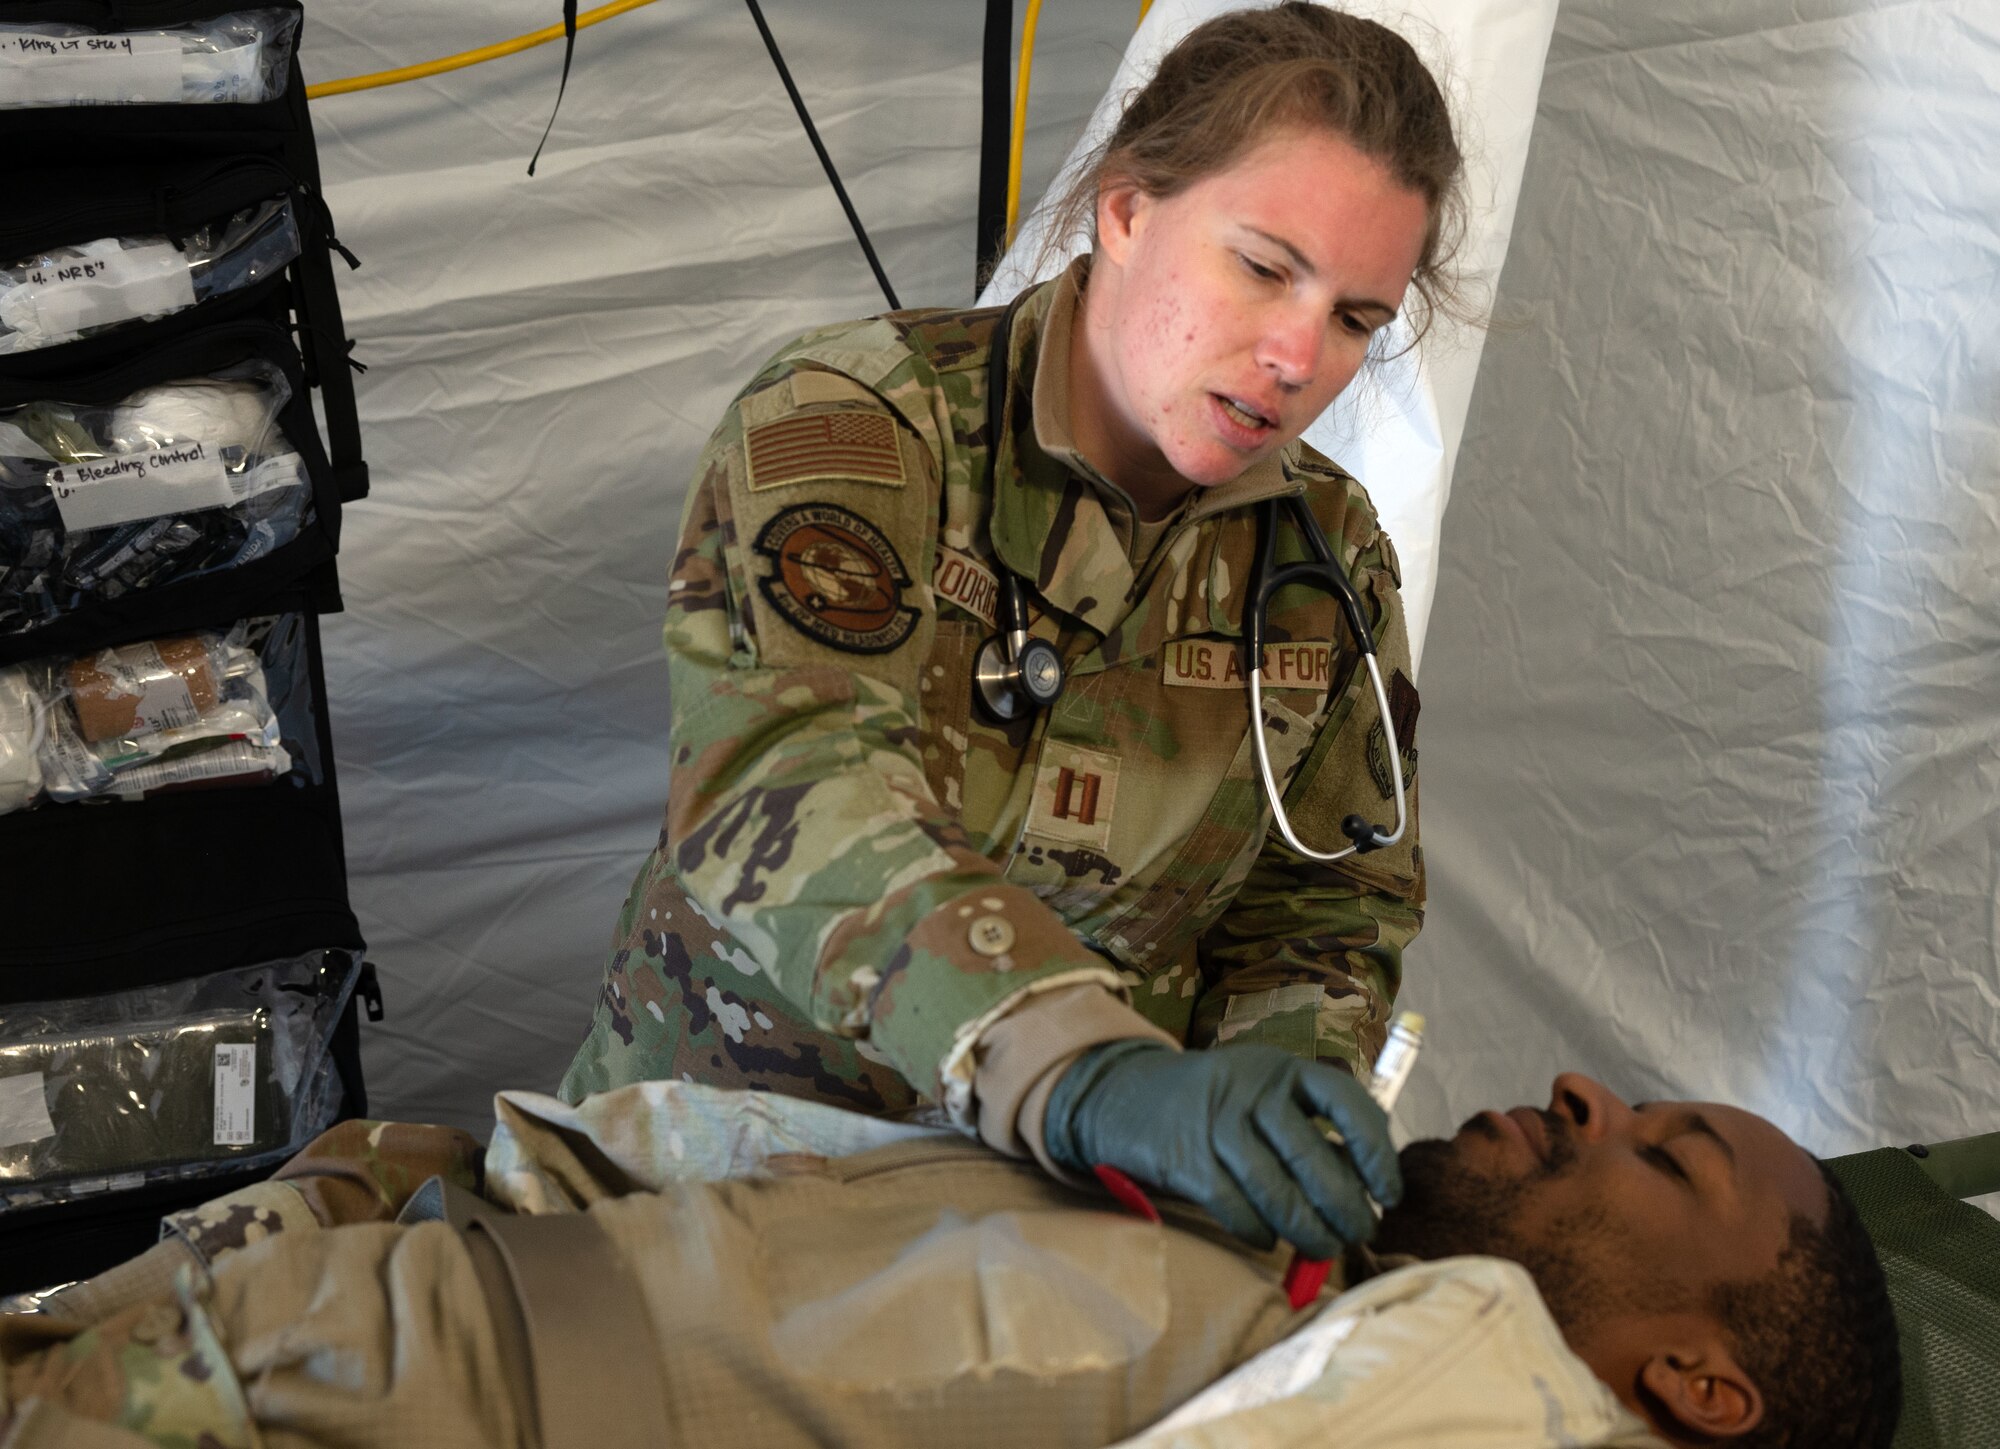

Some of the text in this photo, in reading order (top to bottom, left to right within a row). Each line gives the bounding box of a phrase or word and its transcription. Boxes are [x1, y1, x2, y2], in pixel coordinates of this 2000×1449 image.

[121, 38, 132, 55] 4
[77, 459, 146, 482] Bleeding
[1175, 643, 1216, 681] U.S.
